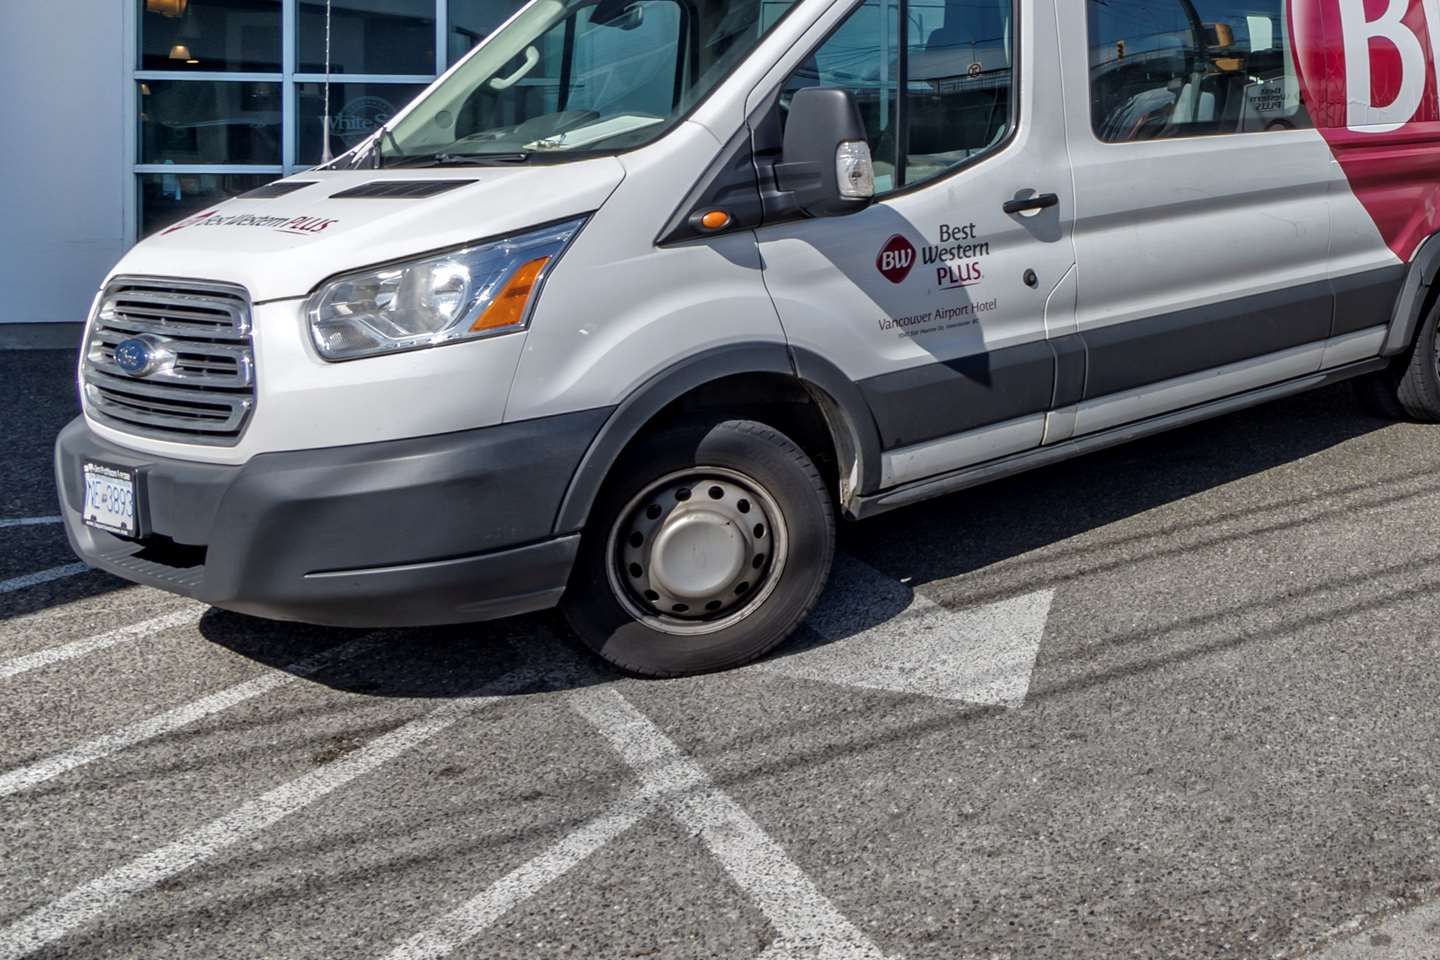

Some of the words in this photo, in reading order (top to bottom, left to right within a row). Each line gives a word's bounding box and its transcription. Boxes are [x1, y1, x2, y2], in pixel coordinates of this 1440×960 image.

[288, 216, 339, 233] PLUS
[939, 222, 976, 242] Best
[881, 248, 912, 271] BW
[922, 241, 990, 264] Western
[937, 262, 981, 286] PLUS
[878, 312, 932, 330] Vancouver
[934, 305, 968, 321] Airport
[971, 298, 997, 315] Hotel
